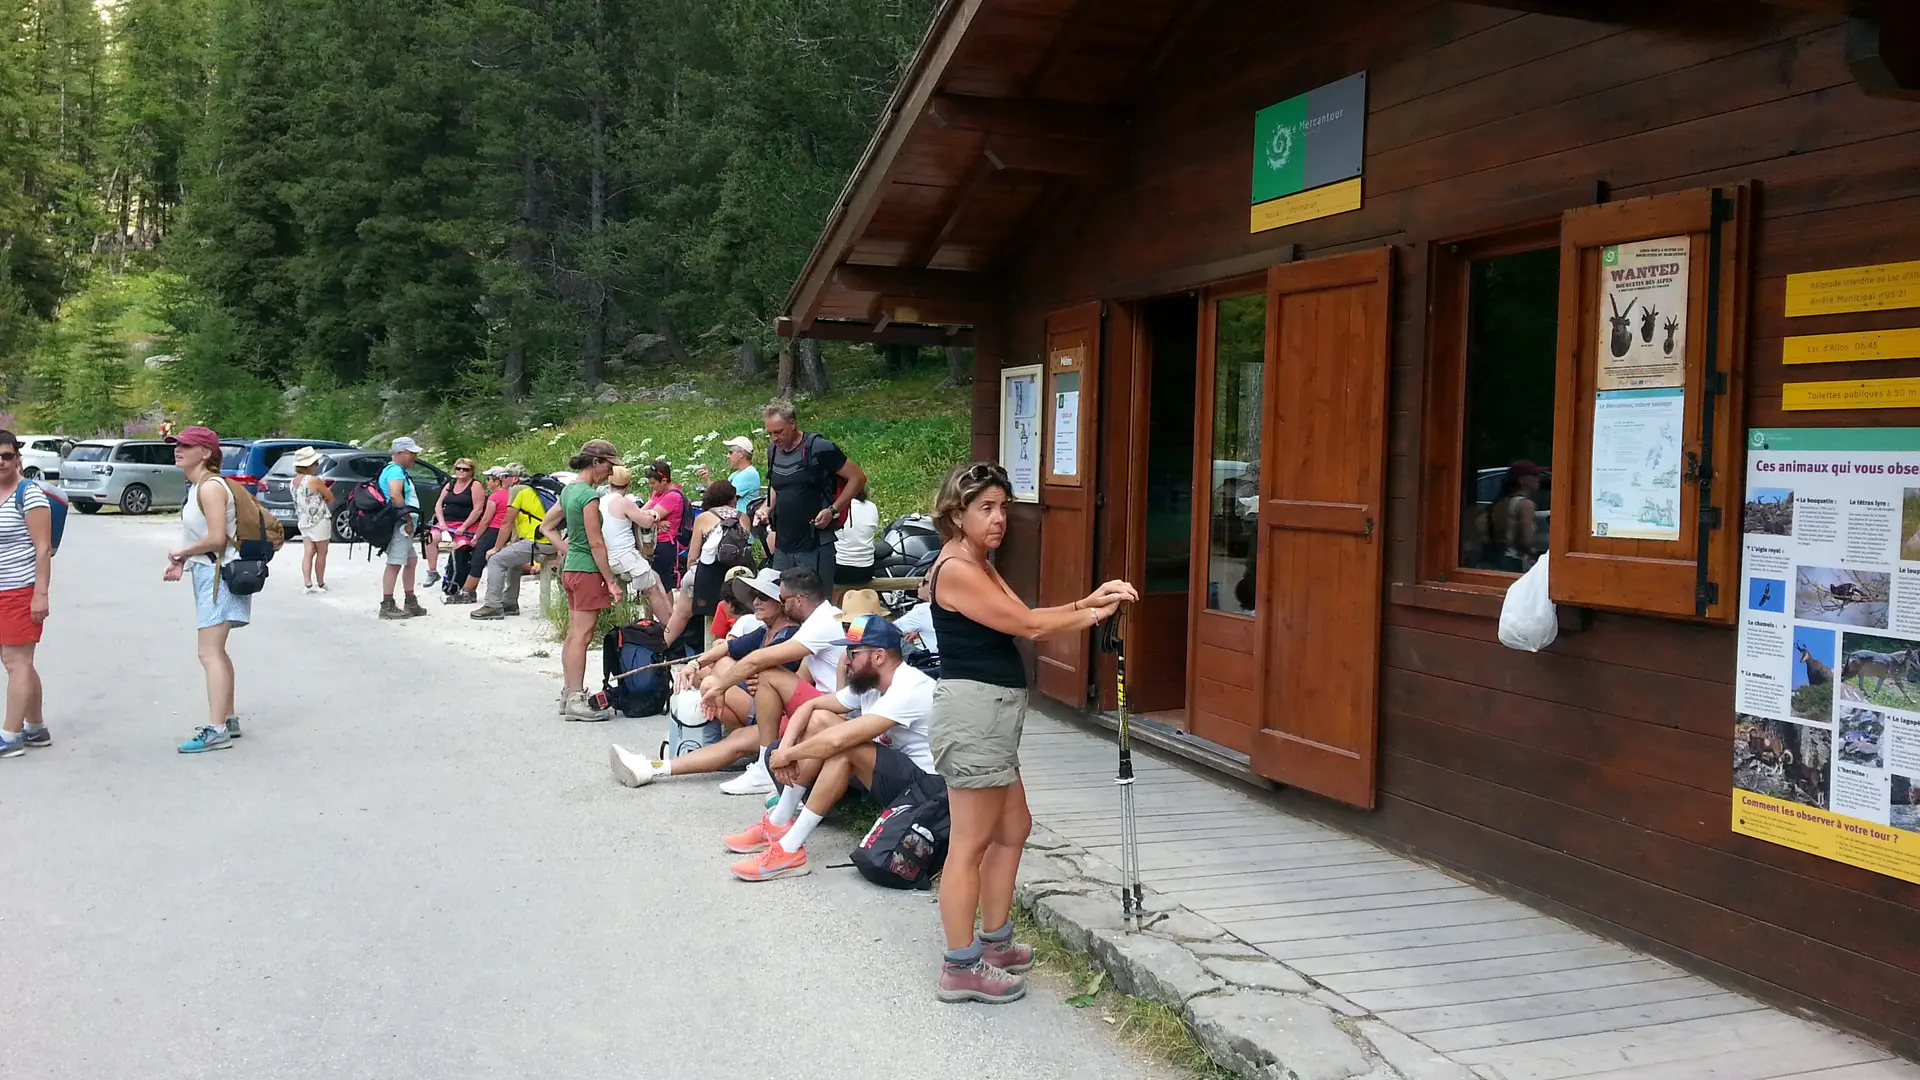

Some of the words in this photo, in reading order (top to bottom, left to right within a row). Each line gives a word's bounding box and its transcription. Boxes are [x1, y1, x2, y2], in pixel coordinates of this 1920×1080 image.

[1299, 109, 1344, 131] Mercantour
[1610, 262, 1680, 283] WANTED
[1616, 280, 1645, 289] BOUQUETIN
[1656, 277, 1673, 285] ALPES
[1811, 280, 1842, 290] Baignade
[1843, 277, 1875, 287] interdite
[1887, 274, 1899, 282] Lac
[1810, 296, 1834, 306] Arrêté
[1837, 293, 1876, 304] Municipal
[1807, 345, 1820, 353] Lac
[1823, 343, 1849, 352] d'Allos
[1807, 391, 1841, 400] Toilettes
[1844, 389, 1884, 400] publiques
[1894, 389, 1905, 397] 50
[1756, 460, 1776, 472] Ces
[1778, 460, 1829, 474] animaux
[1831, 461, 1852, 476] qui
[1853, 463, 1884, 475] vous
[1887, 461, 1920, 475] obse
[1807, 497, 1834, 505] bouquetin
[1874, 500, 1886, 508] lyre
[1751, 545, 1767, 554] L'aigle
[1768, 547, 1782, 555] royal
[1907, 567, 1920, 575] loup
[1754, 620, 1775, 629] chamois
[1745, 670, 1752, 678] Le
[1752, 671, 1772, 680] mouflon
[1837, 765, 1866, 777] L'hermine
[1741, 796, 1780, 814] Comment
[1781, 804, 1795, 817] les
[1796, 806, 1836, 828] observer
[1836, 818, 1843, 829] à
[1844, 822, 1868, 836] votre
[1869, 827, 1891, 842] tour
[1893, 833, 1900, 844] ?
